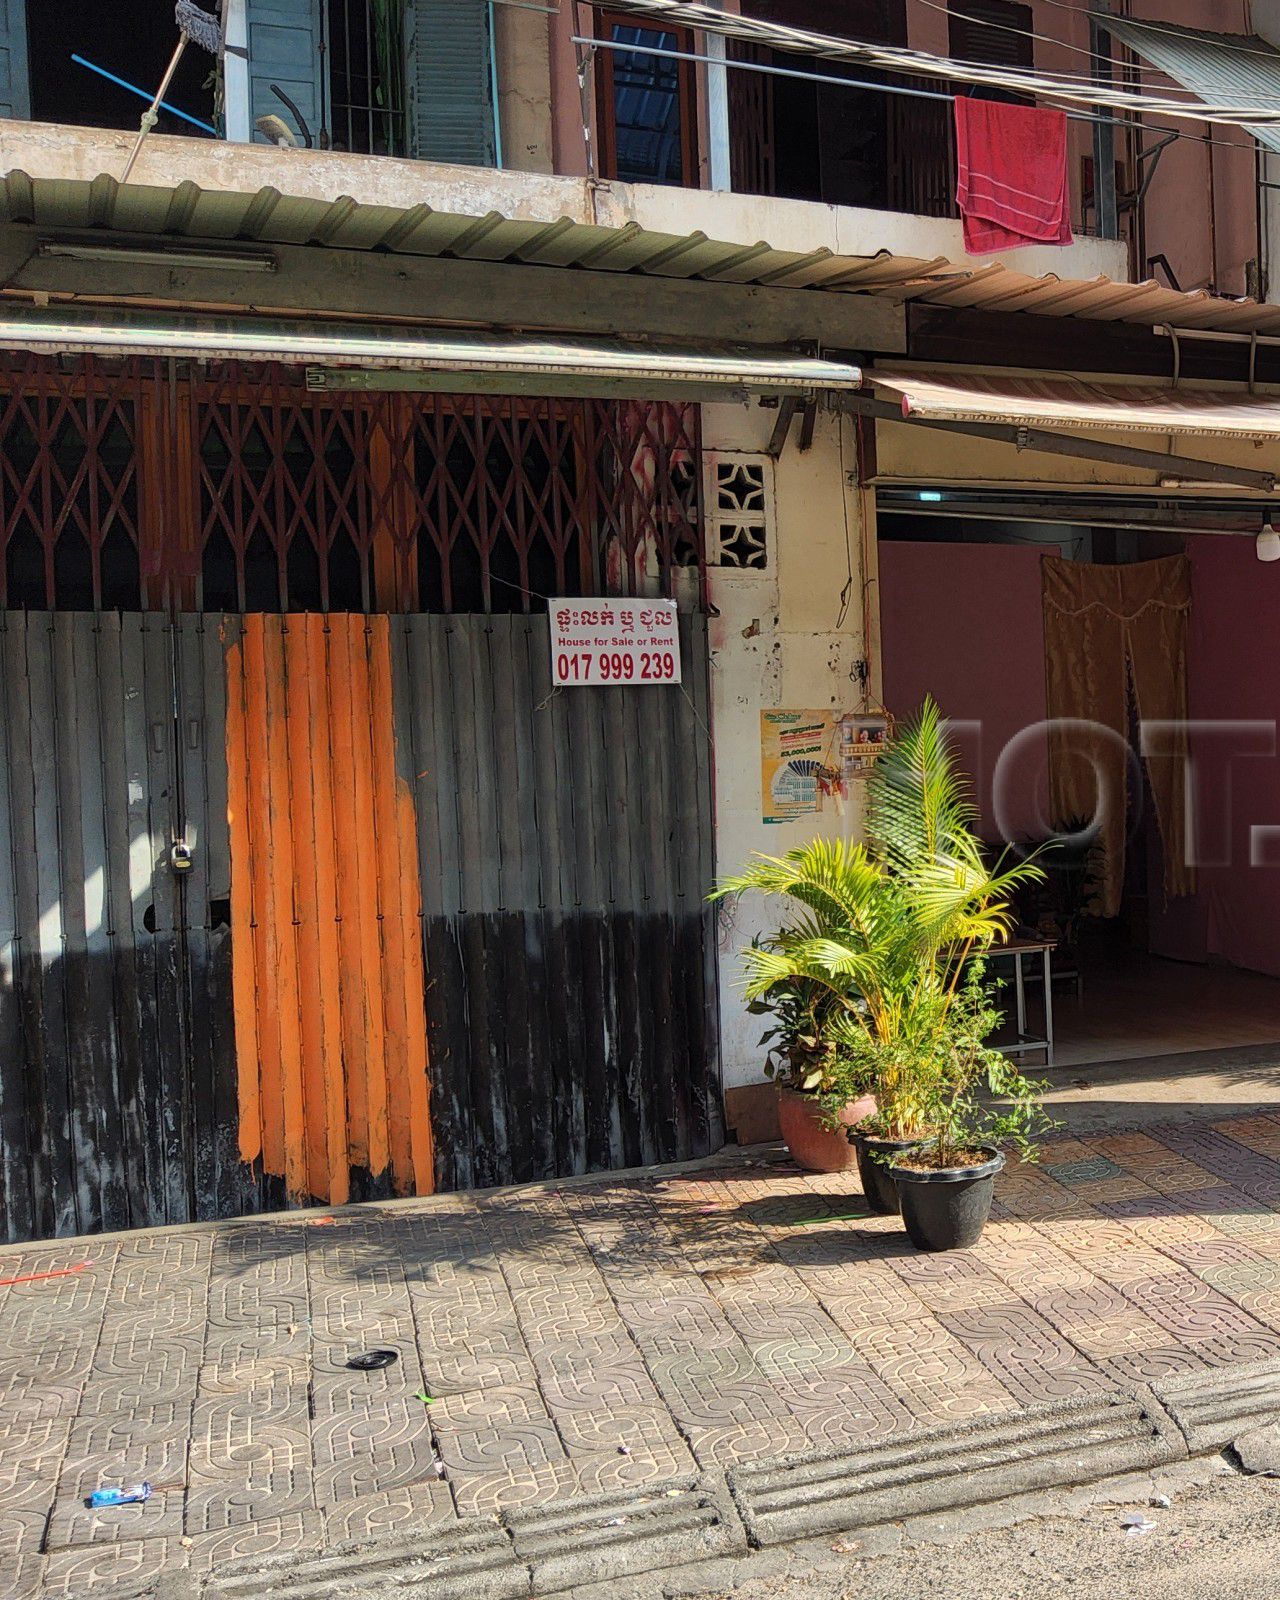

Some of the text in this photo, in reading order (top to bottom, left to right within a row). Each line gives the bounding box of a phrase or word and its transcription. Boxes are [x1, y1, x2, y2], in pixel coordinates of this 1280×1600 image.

[640, 608, 673, 632] ជួល
[558, 637, 591, 646] House
[594, 637, 609, 646] for
[611, 637, 634, 646] Sale
[650, 637, 674, 646] Rent
[557, 652, 674, 680] 017 999 239
